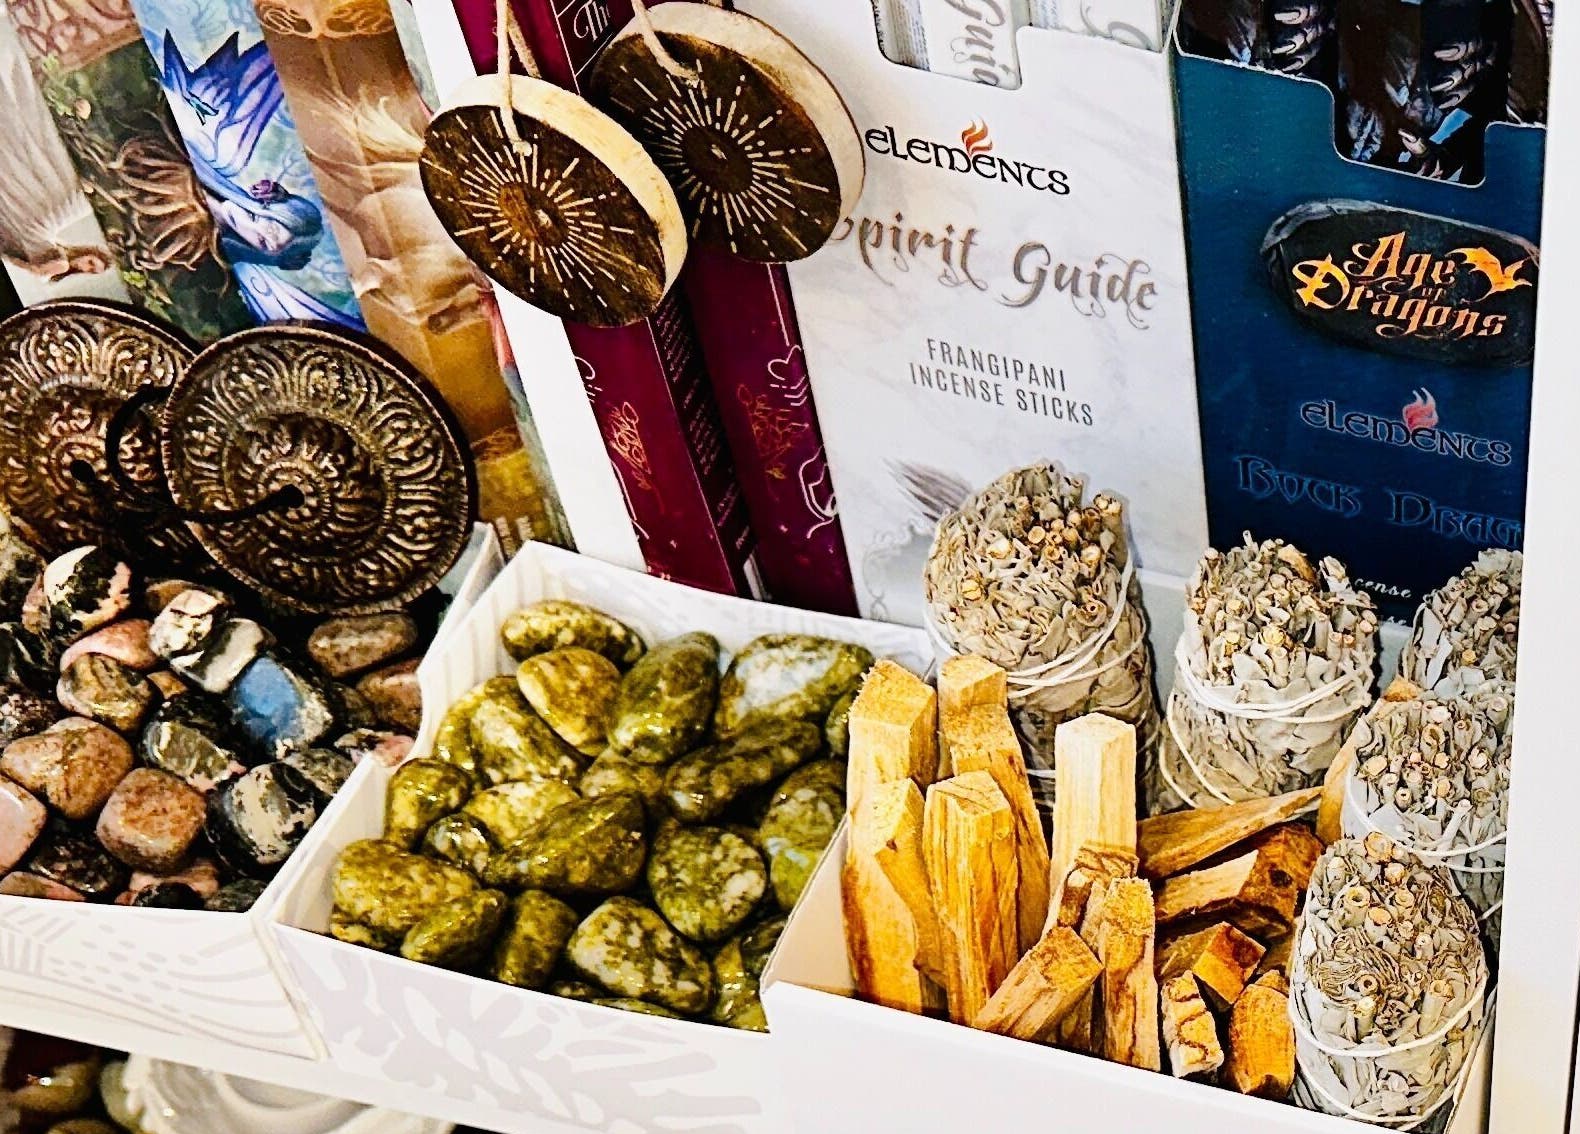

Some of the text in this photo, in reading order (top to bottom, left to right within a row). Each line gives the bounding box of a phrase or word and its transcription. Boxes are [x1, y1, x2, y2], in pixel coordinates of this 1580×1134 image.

[999, 240, 1158, 330] Guide
[1343, 230, 1456, 295] Age
[1291, 252, 1507, 341] Dragons
[909, 362, 1094, 427] INCENSE STICKS
[926, 337, 1067, 392] FRANGIPANI
[1384, 488, 1522, 548] DRAG
[1354, 578, 1412, 598] cense
